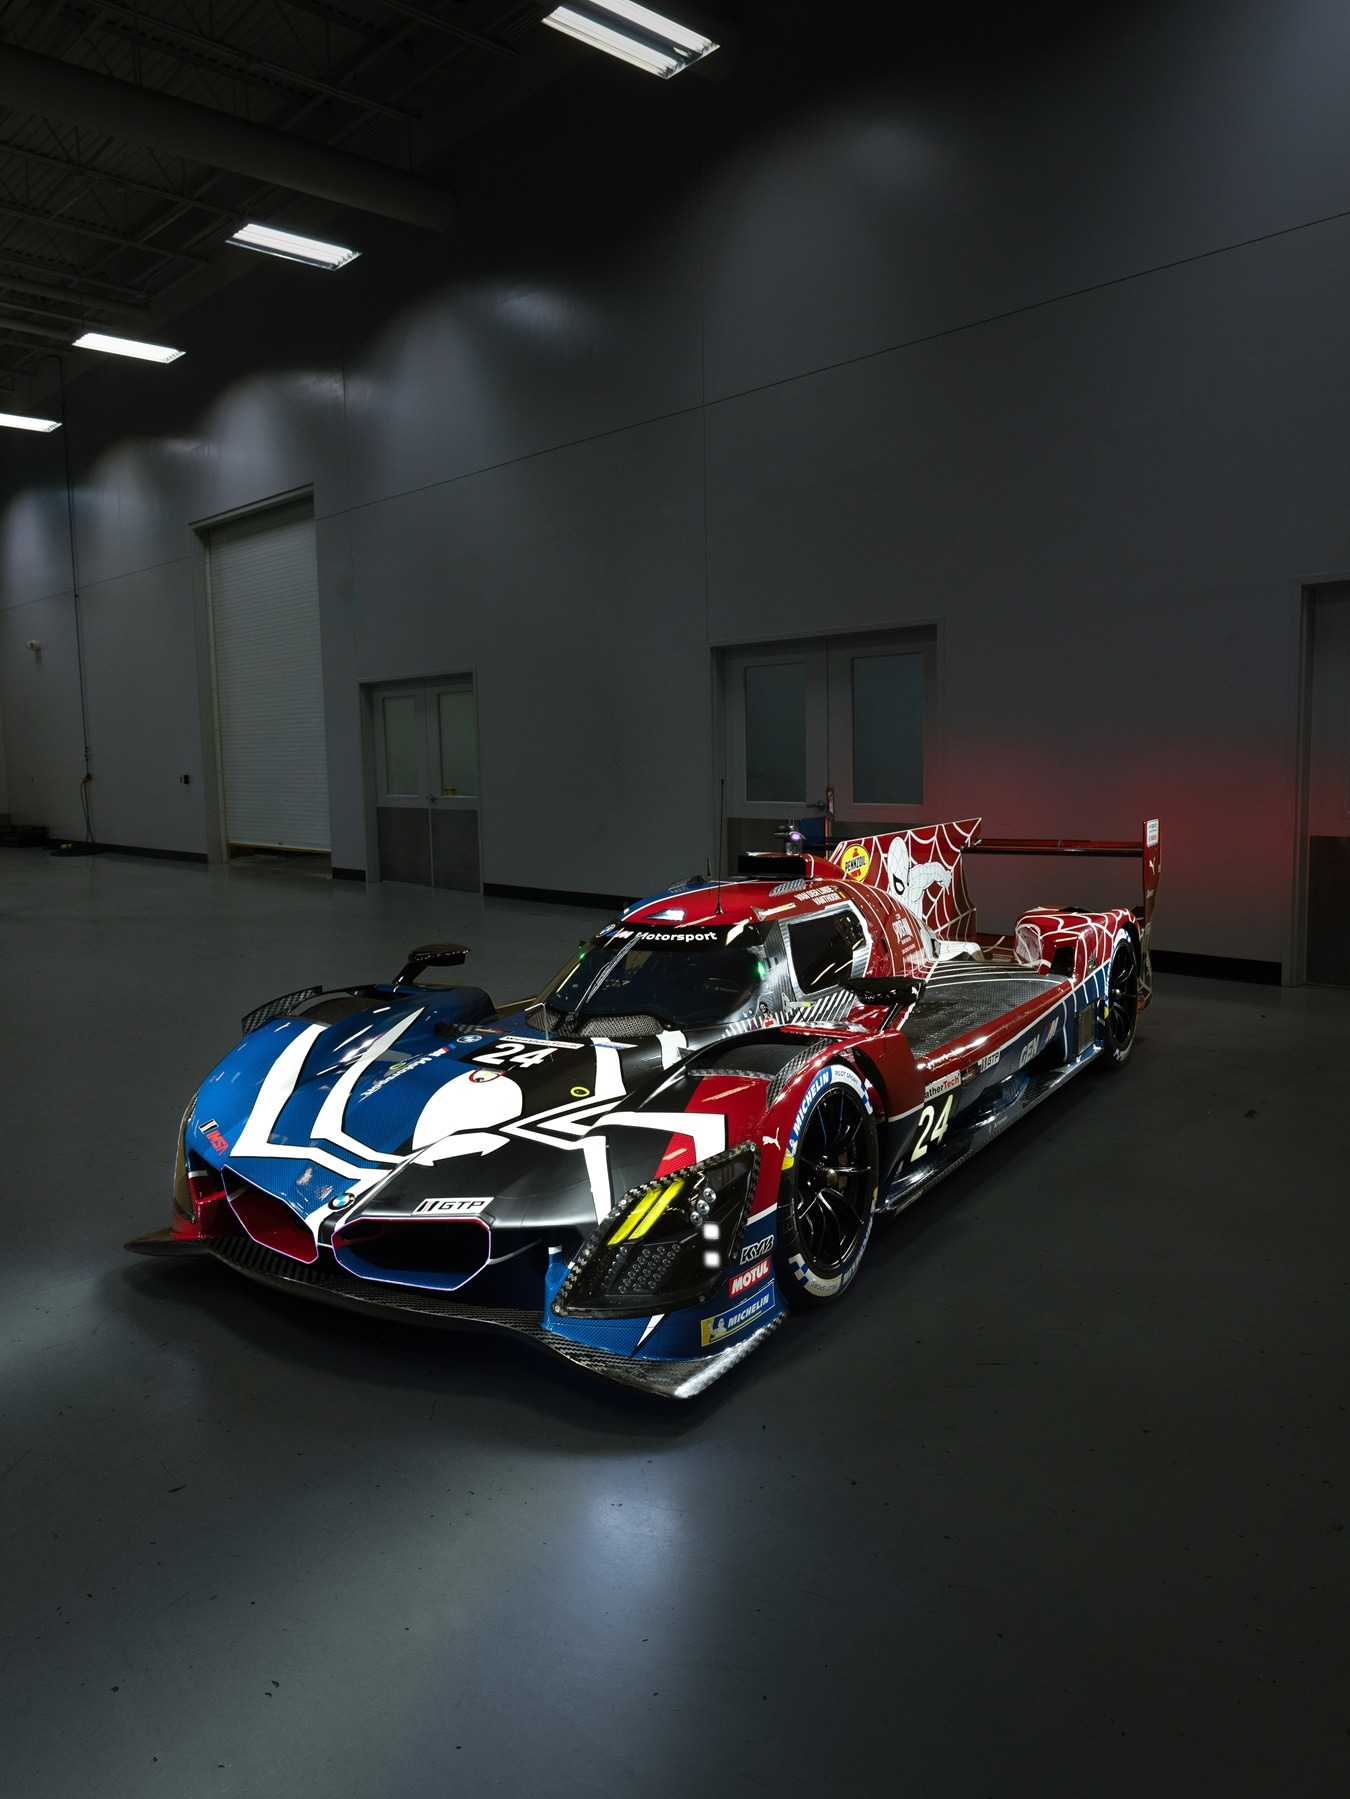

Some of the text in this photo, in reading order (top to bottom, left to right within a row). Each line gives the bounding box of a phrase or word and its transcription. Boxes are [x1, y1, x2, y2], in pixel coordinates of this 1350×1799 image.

[845, 857, 866, 872] PENNZOIL
[636, 931, 718, 942] Motorsport
[472, 1043, 558, 1068] 24
[987, 1052, 999, 1066] GTP
[1019, 1034, 1040, 1068] GEN
[793, 1071, 829, 1136] MICHELIN
[846, 1072, 859, 1085] SPORT
[910, 1094, 954, 1162] 24
[206, 1130, 229, 1156] IMSA
[437, 1200, 485, 1210] GTP
[741, 1235, 774, 1264] KYB
[731, 1260, 769, 1295] MOTUL
[728, 1294, 770, 1328] MICHELIN
